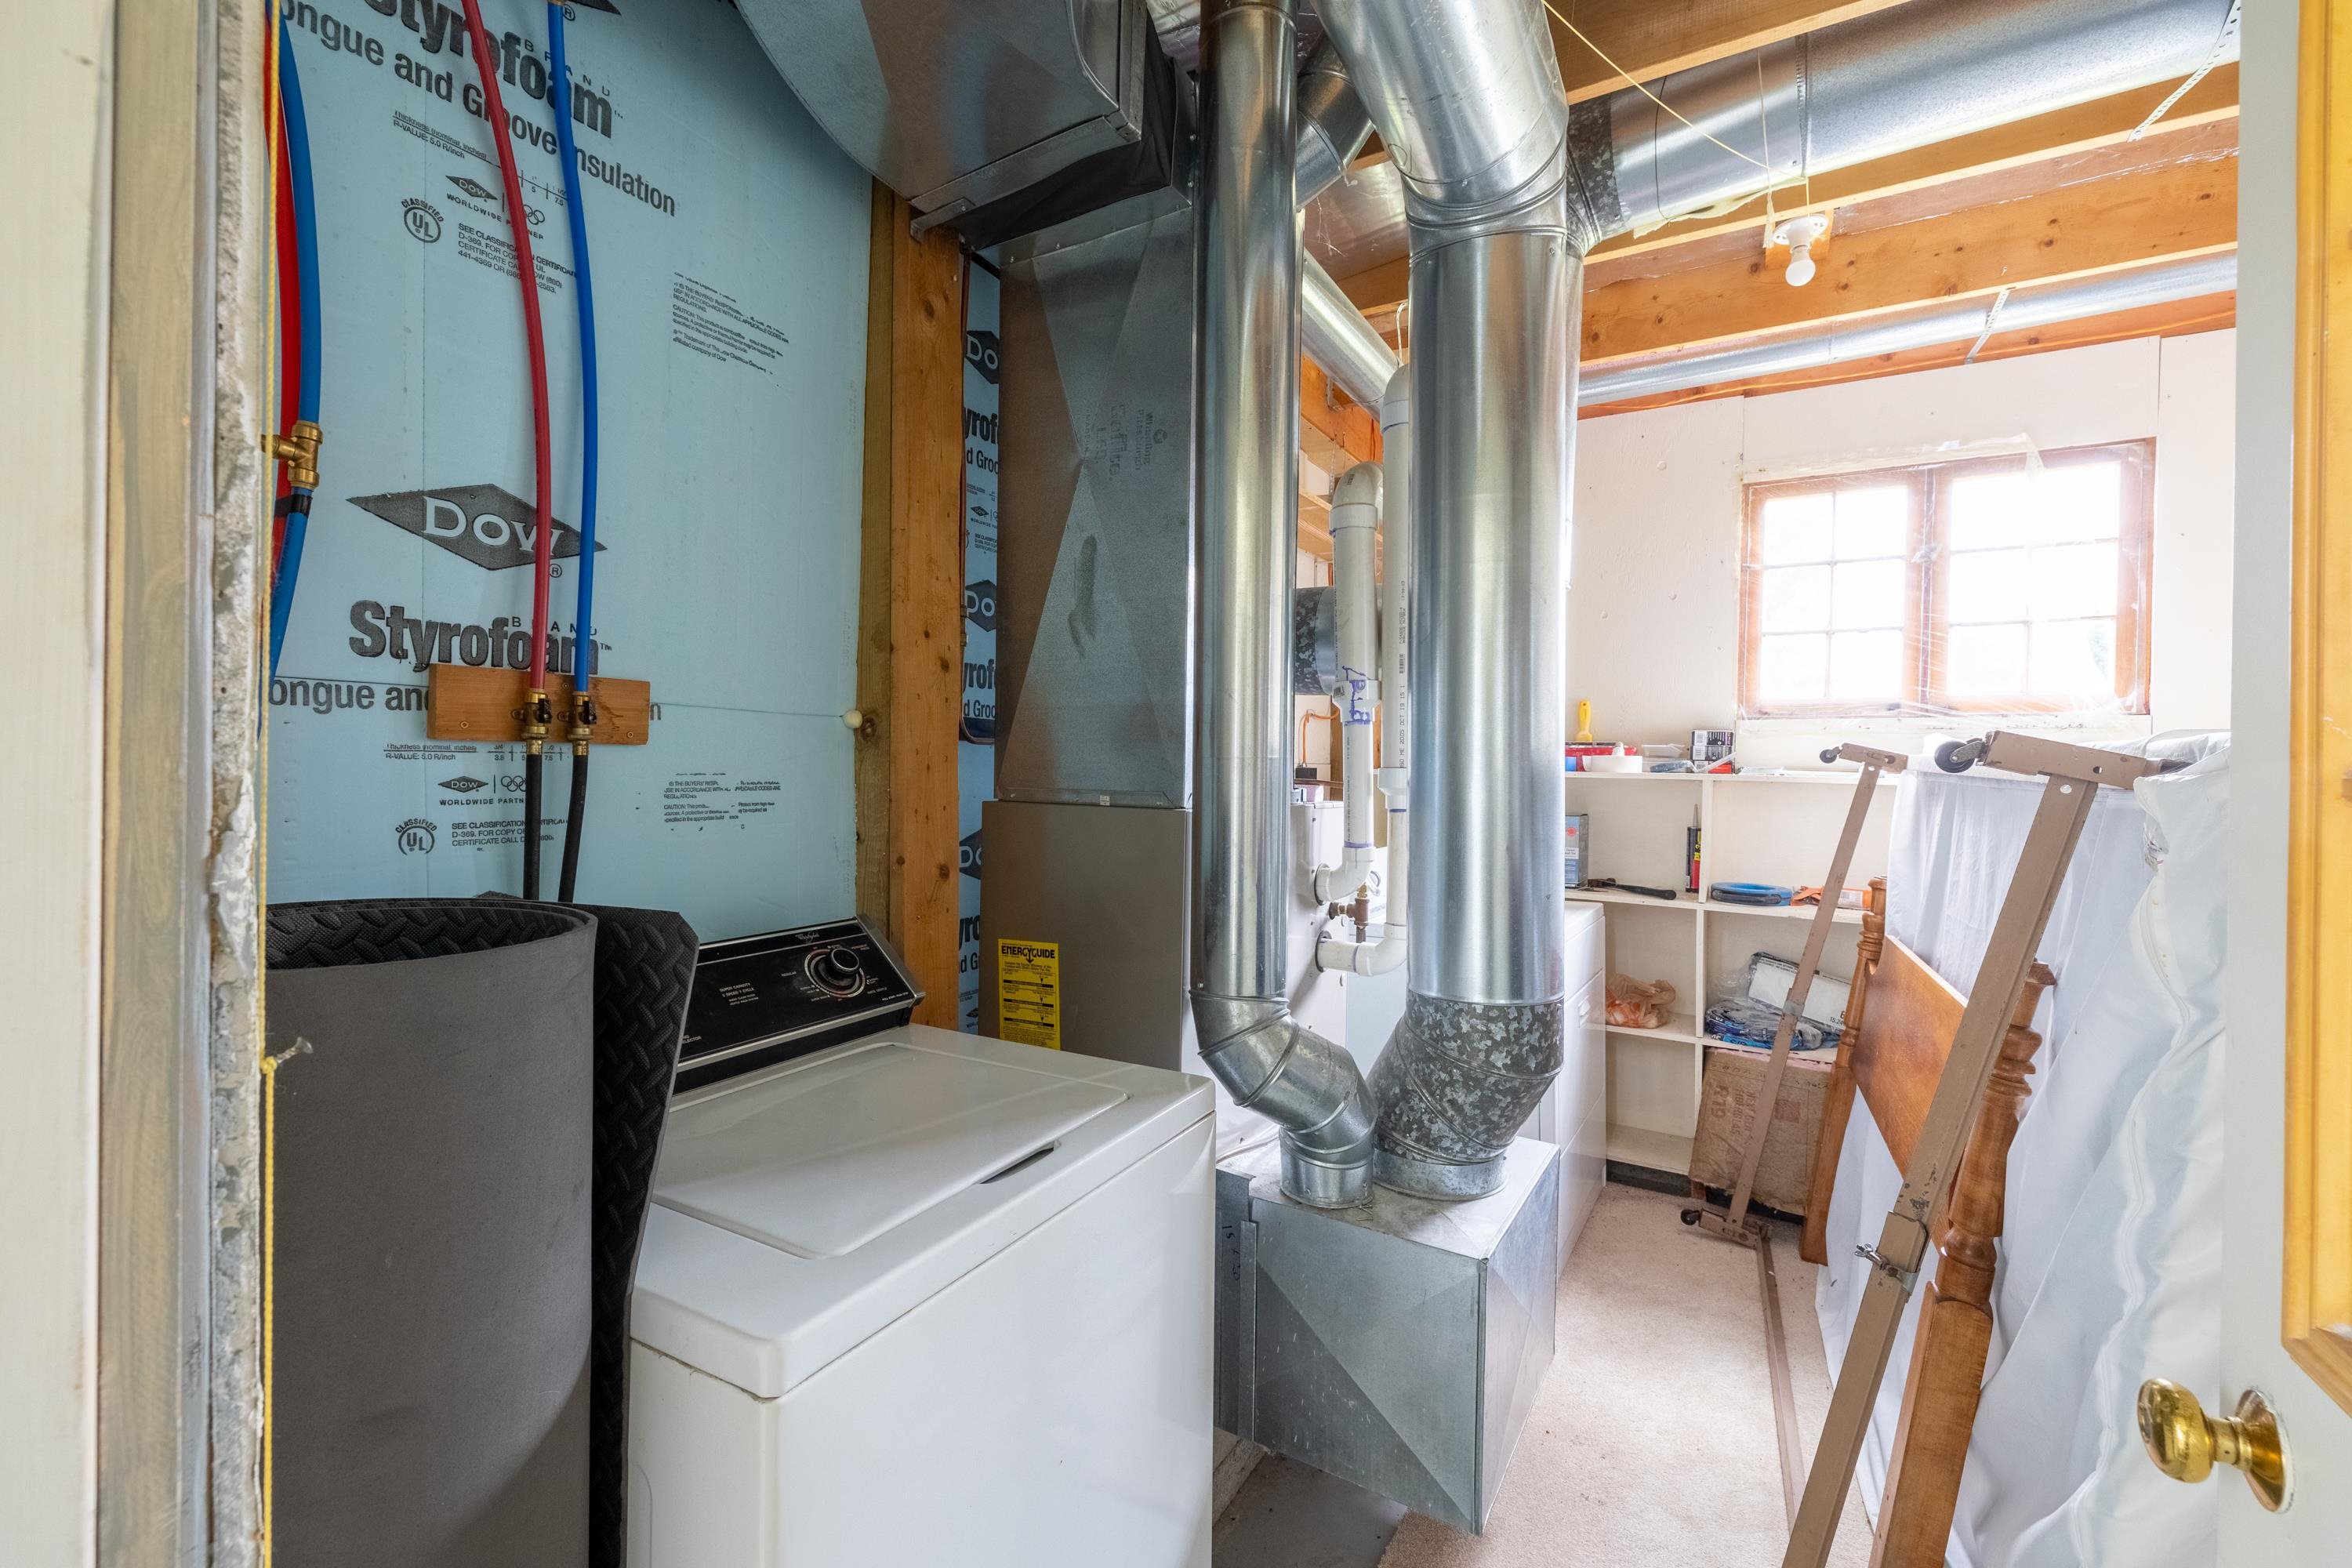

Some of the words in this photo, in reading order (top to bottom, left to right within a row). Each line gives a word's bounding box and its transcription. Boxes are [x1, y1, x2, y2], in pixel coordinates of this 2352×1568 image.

[364, 0, 612, 138] tyrfom
[394, 119, 429, 142] R-VALUE:
[430, 136, 441, 147] 5.0
[394, 53, 452, 103] and
[463, 83, 557, 155] Gove
[575, 147, 675, 216] nsulation
[401, 198, 445, 223] CLASSIFIED
[447, 193, 503, 223] WORLDWIDE
[506, 219, 544, 240] PNER
[459, 223, 474, 235] SEE
[458, 241, 506, 265] CERTIFICATE
[459, 233, 482, 247] D-369.
[485, 243, 501, 256] FOR
[503, 247, 519, 261] COP
[458, 250, 492, 268] 441-4369
[494, 264, 505, 274] OR
[966, 333, 999, 371] DO
[422, 495, 566, 557] DOW
[965, 590, 996, 618] DO
[268, 679, 375, 715] ongue
[395, 818, 437, 834] CLASSIFIED
[406, 832, 427, 851] UL
[452, 837, 499, 848] CERTIFICATE
[1001, 946, 1055, 960] ENERGYGUIDE
